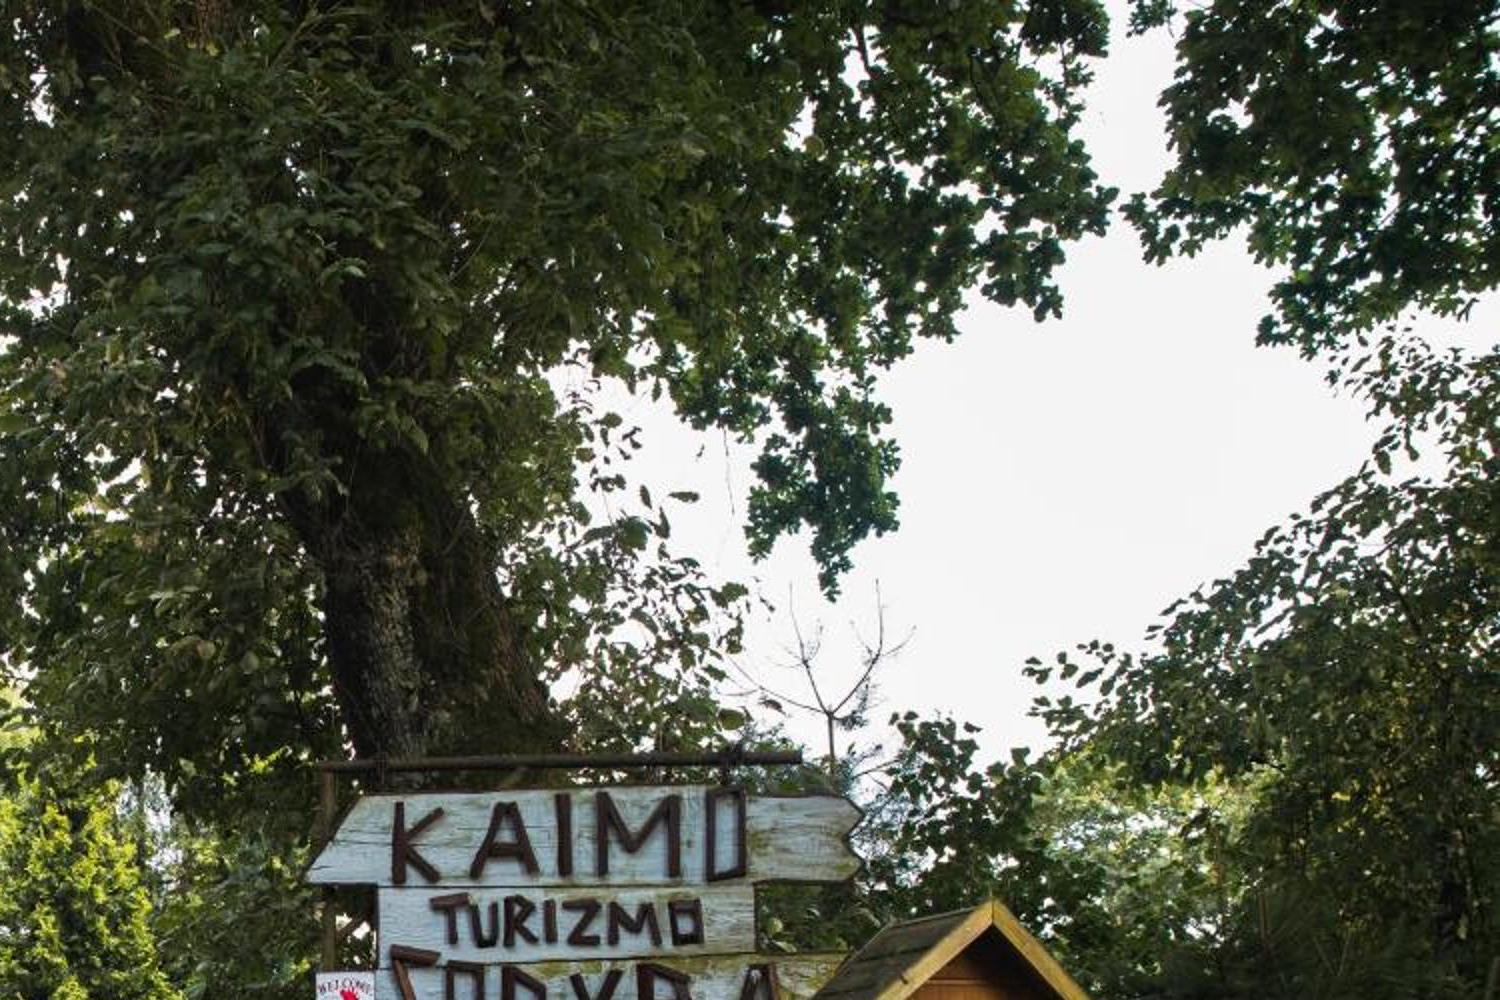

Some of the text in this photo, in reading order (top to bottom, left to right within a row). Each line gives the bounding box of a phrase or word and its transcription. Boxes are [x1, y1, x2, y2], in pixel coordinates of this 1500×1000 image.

[391, 786, 747, 884] KAIMO
[430, 892, 705, 948] TURIZMO
[318, 978, 373, 995] WELCOME
